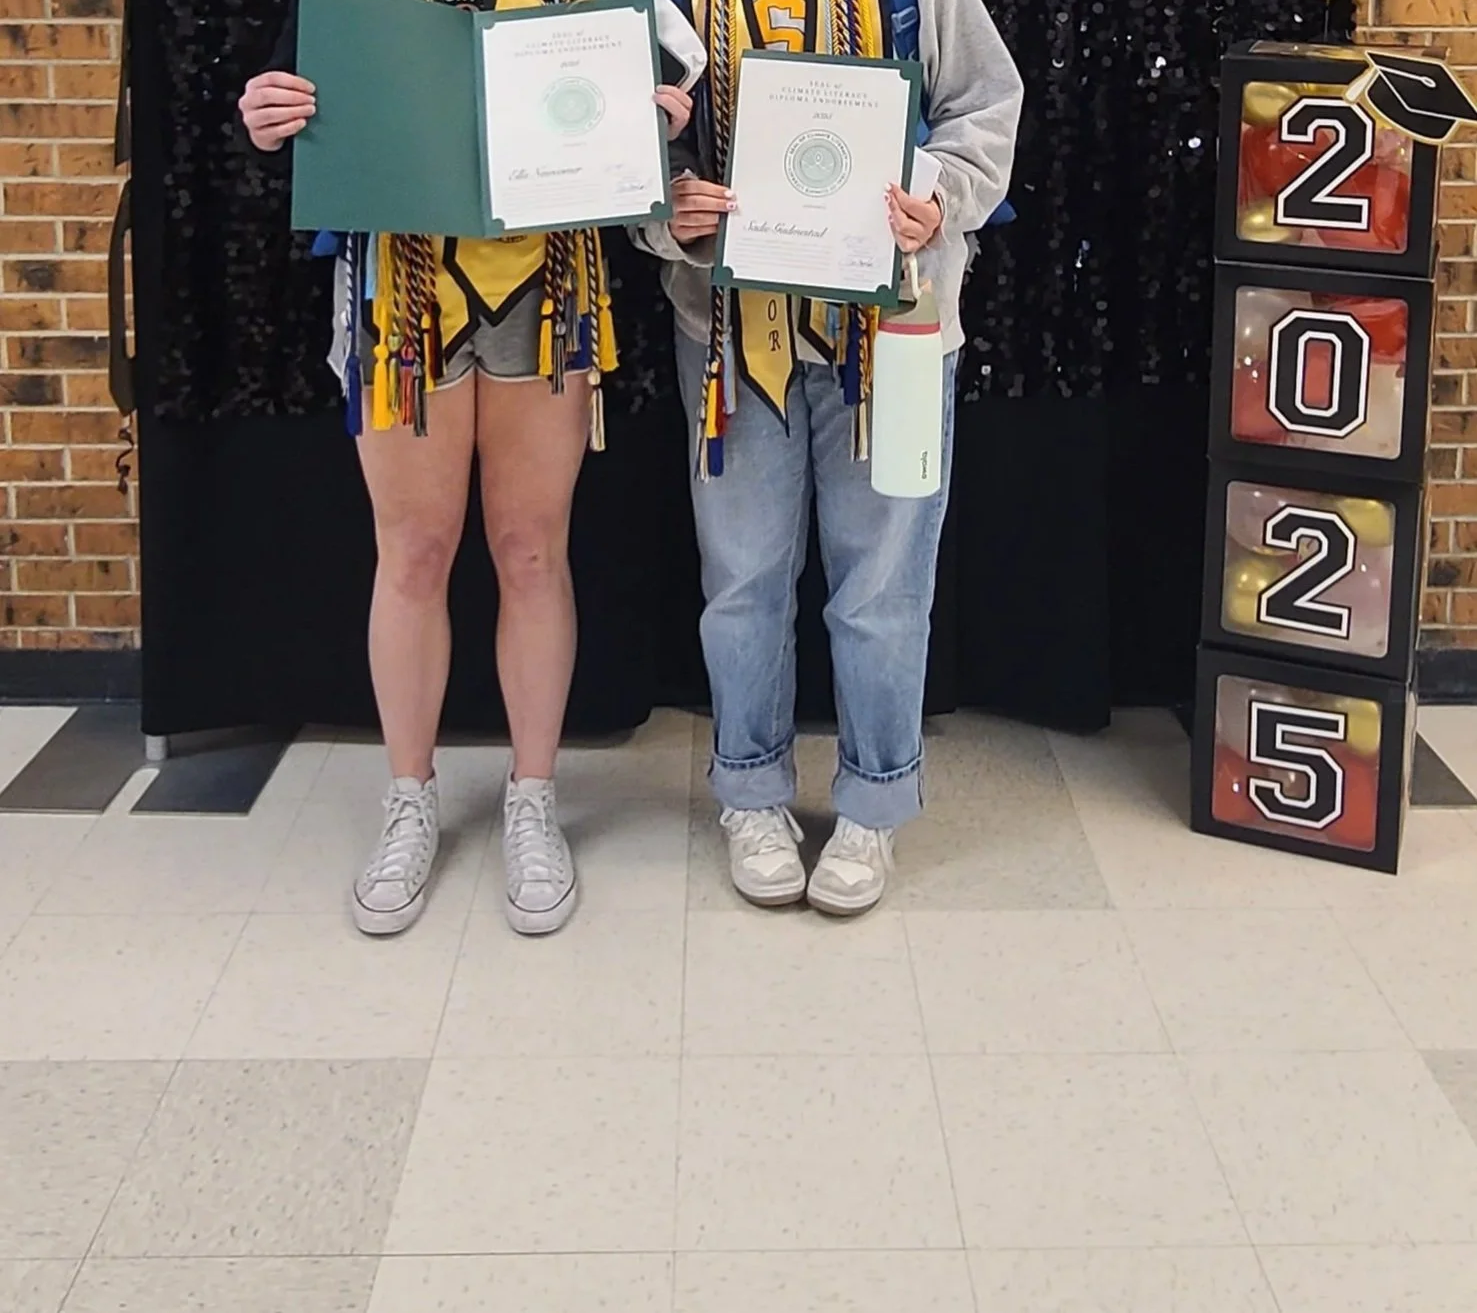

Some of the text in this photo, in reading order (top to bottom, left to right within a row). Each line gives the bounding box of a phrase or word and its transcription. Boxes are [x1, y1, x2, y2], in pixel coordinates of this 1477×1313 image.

[781, 86, 867, 99] CLIMATE LITERACY
[769, 94, 879, 108] DIPLOMA ENDORSEMENT
